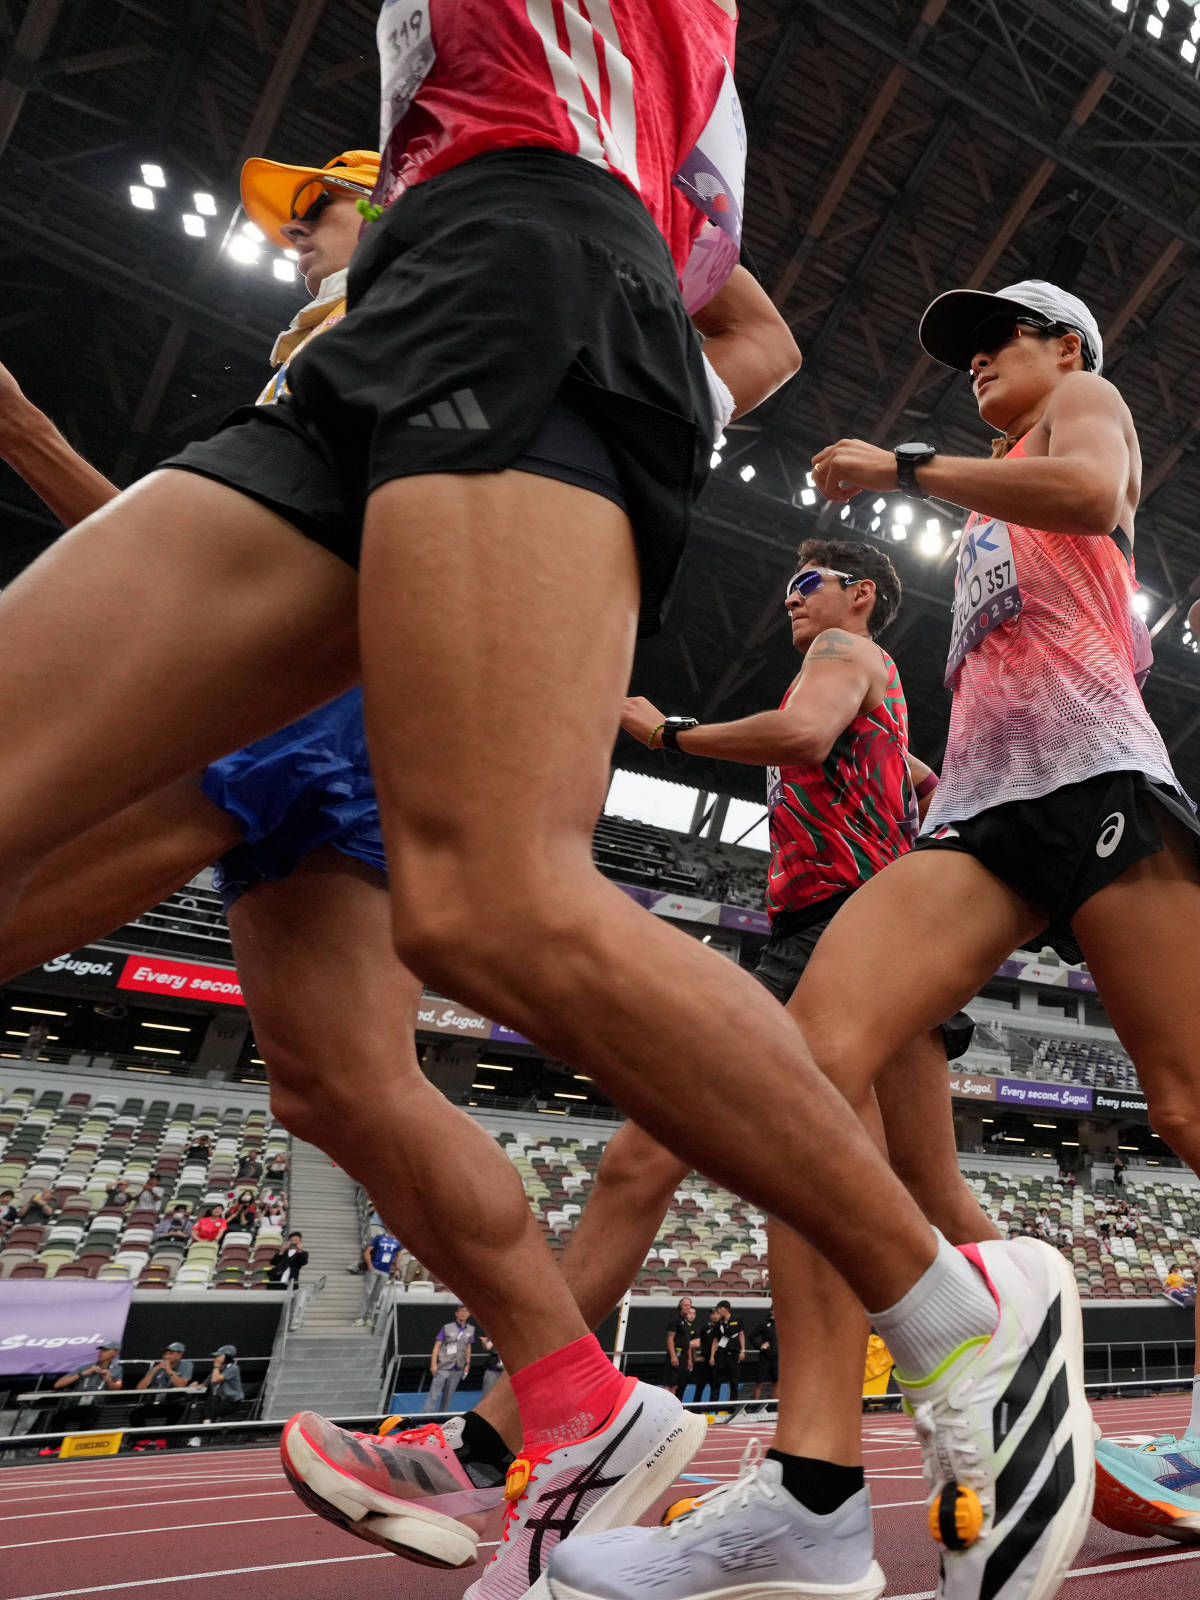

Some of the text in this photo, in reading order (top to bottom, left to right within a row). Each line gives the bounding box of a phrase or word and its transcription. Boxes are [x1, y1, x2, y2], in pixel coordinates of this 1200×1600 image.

[387, 9, 423, 58] 319
[985, 559, 1011, 595] 357
[991, 595, 1014, 618] 25
[43, 953, 113, 976] Sugoi.
[133, 966, 243, 996] Every secon
[436, 1009, 485, 1030] Sugoi.
[961, 1079, 992, 1094] Sugoi.
[1000, 1085, 1089, 1105] Every second, Sugoi.
[1096, 1096, 1120, 1110] Every
